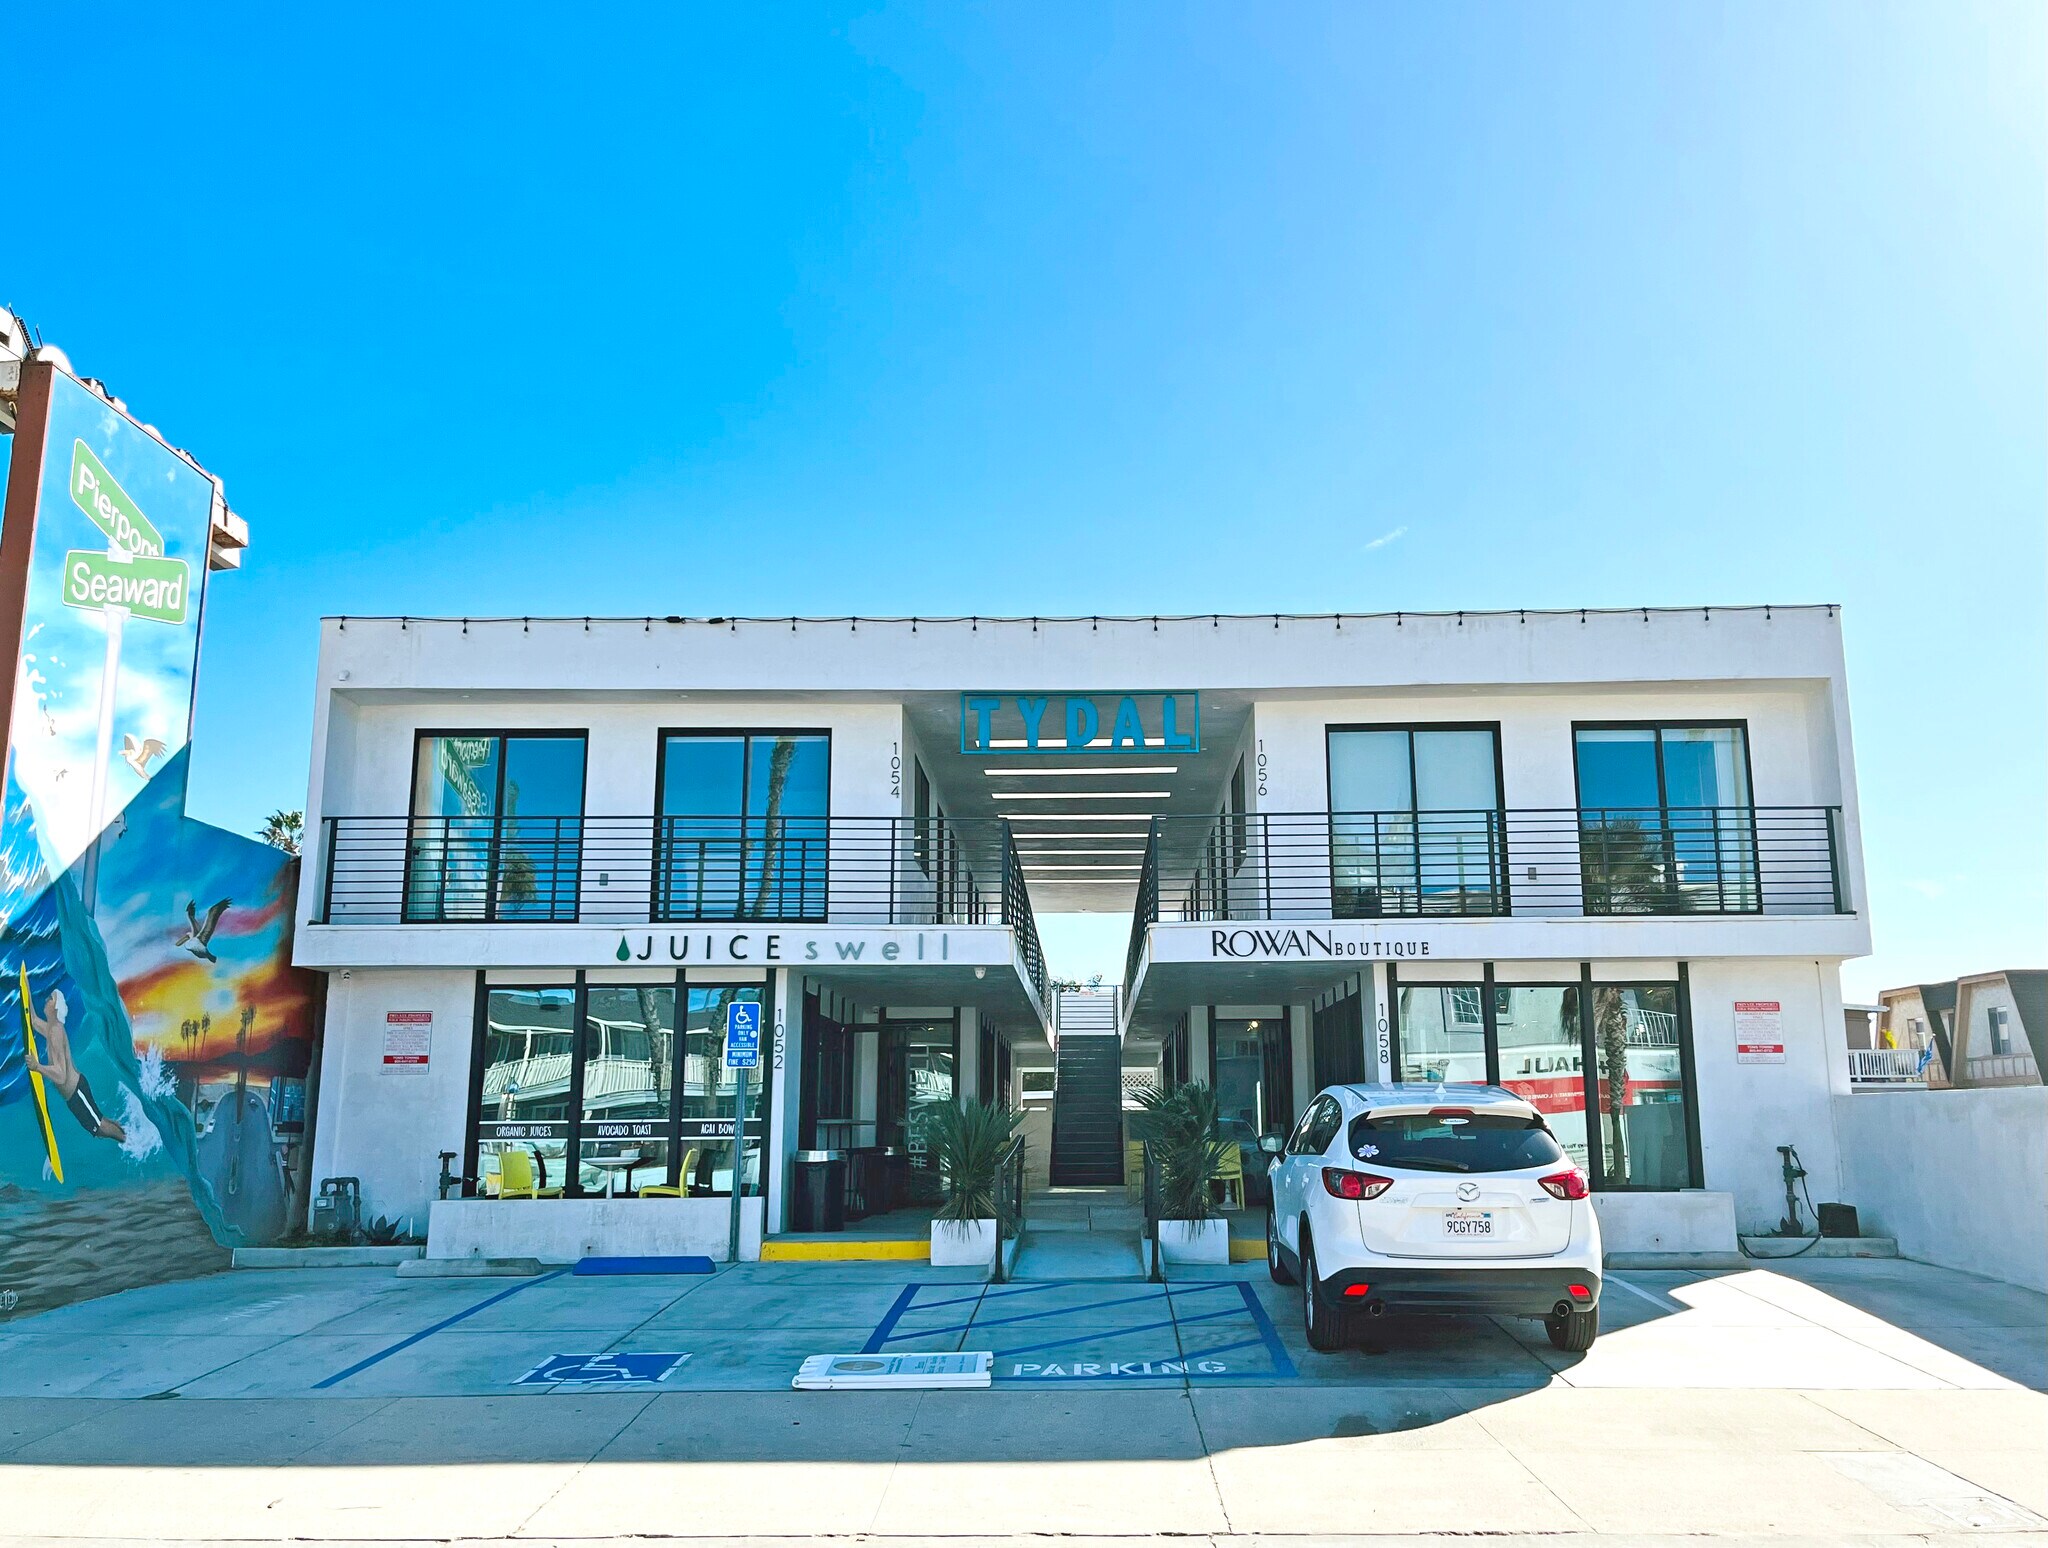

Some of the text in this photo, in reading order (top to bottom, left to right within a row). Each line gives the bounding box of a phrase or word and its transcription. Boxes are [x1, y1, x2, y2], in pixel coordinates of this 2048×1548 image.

[71, 562, 183, 610] Seaward
[969, 696, 1191, 748] TYDAL
[890, 742, 900, 799] 1054
[1257, 739, 1268, 797] 1056
[636, 933, 948, 961] JUICE swell
[1212, 930, 1430, 957] ROWAN BOUTIQUE
[774, 1008, 784, 1069] 1052
[1377, 1003, 1389, 1063] 1058
[742, 1058, 756, 1066] $250
[496, 1125, 552, 1137] ORGANIC JUICES
[597, 1124, 652, 1136] AVOCADO TOAST
[700, 1123, 735, 1134] ACAI BOW
[1446, 1220, 1491, 1233] 9CGY758
[1013, 1361, 1227, 1376] PARKING
